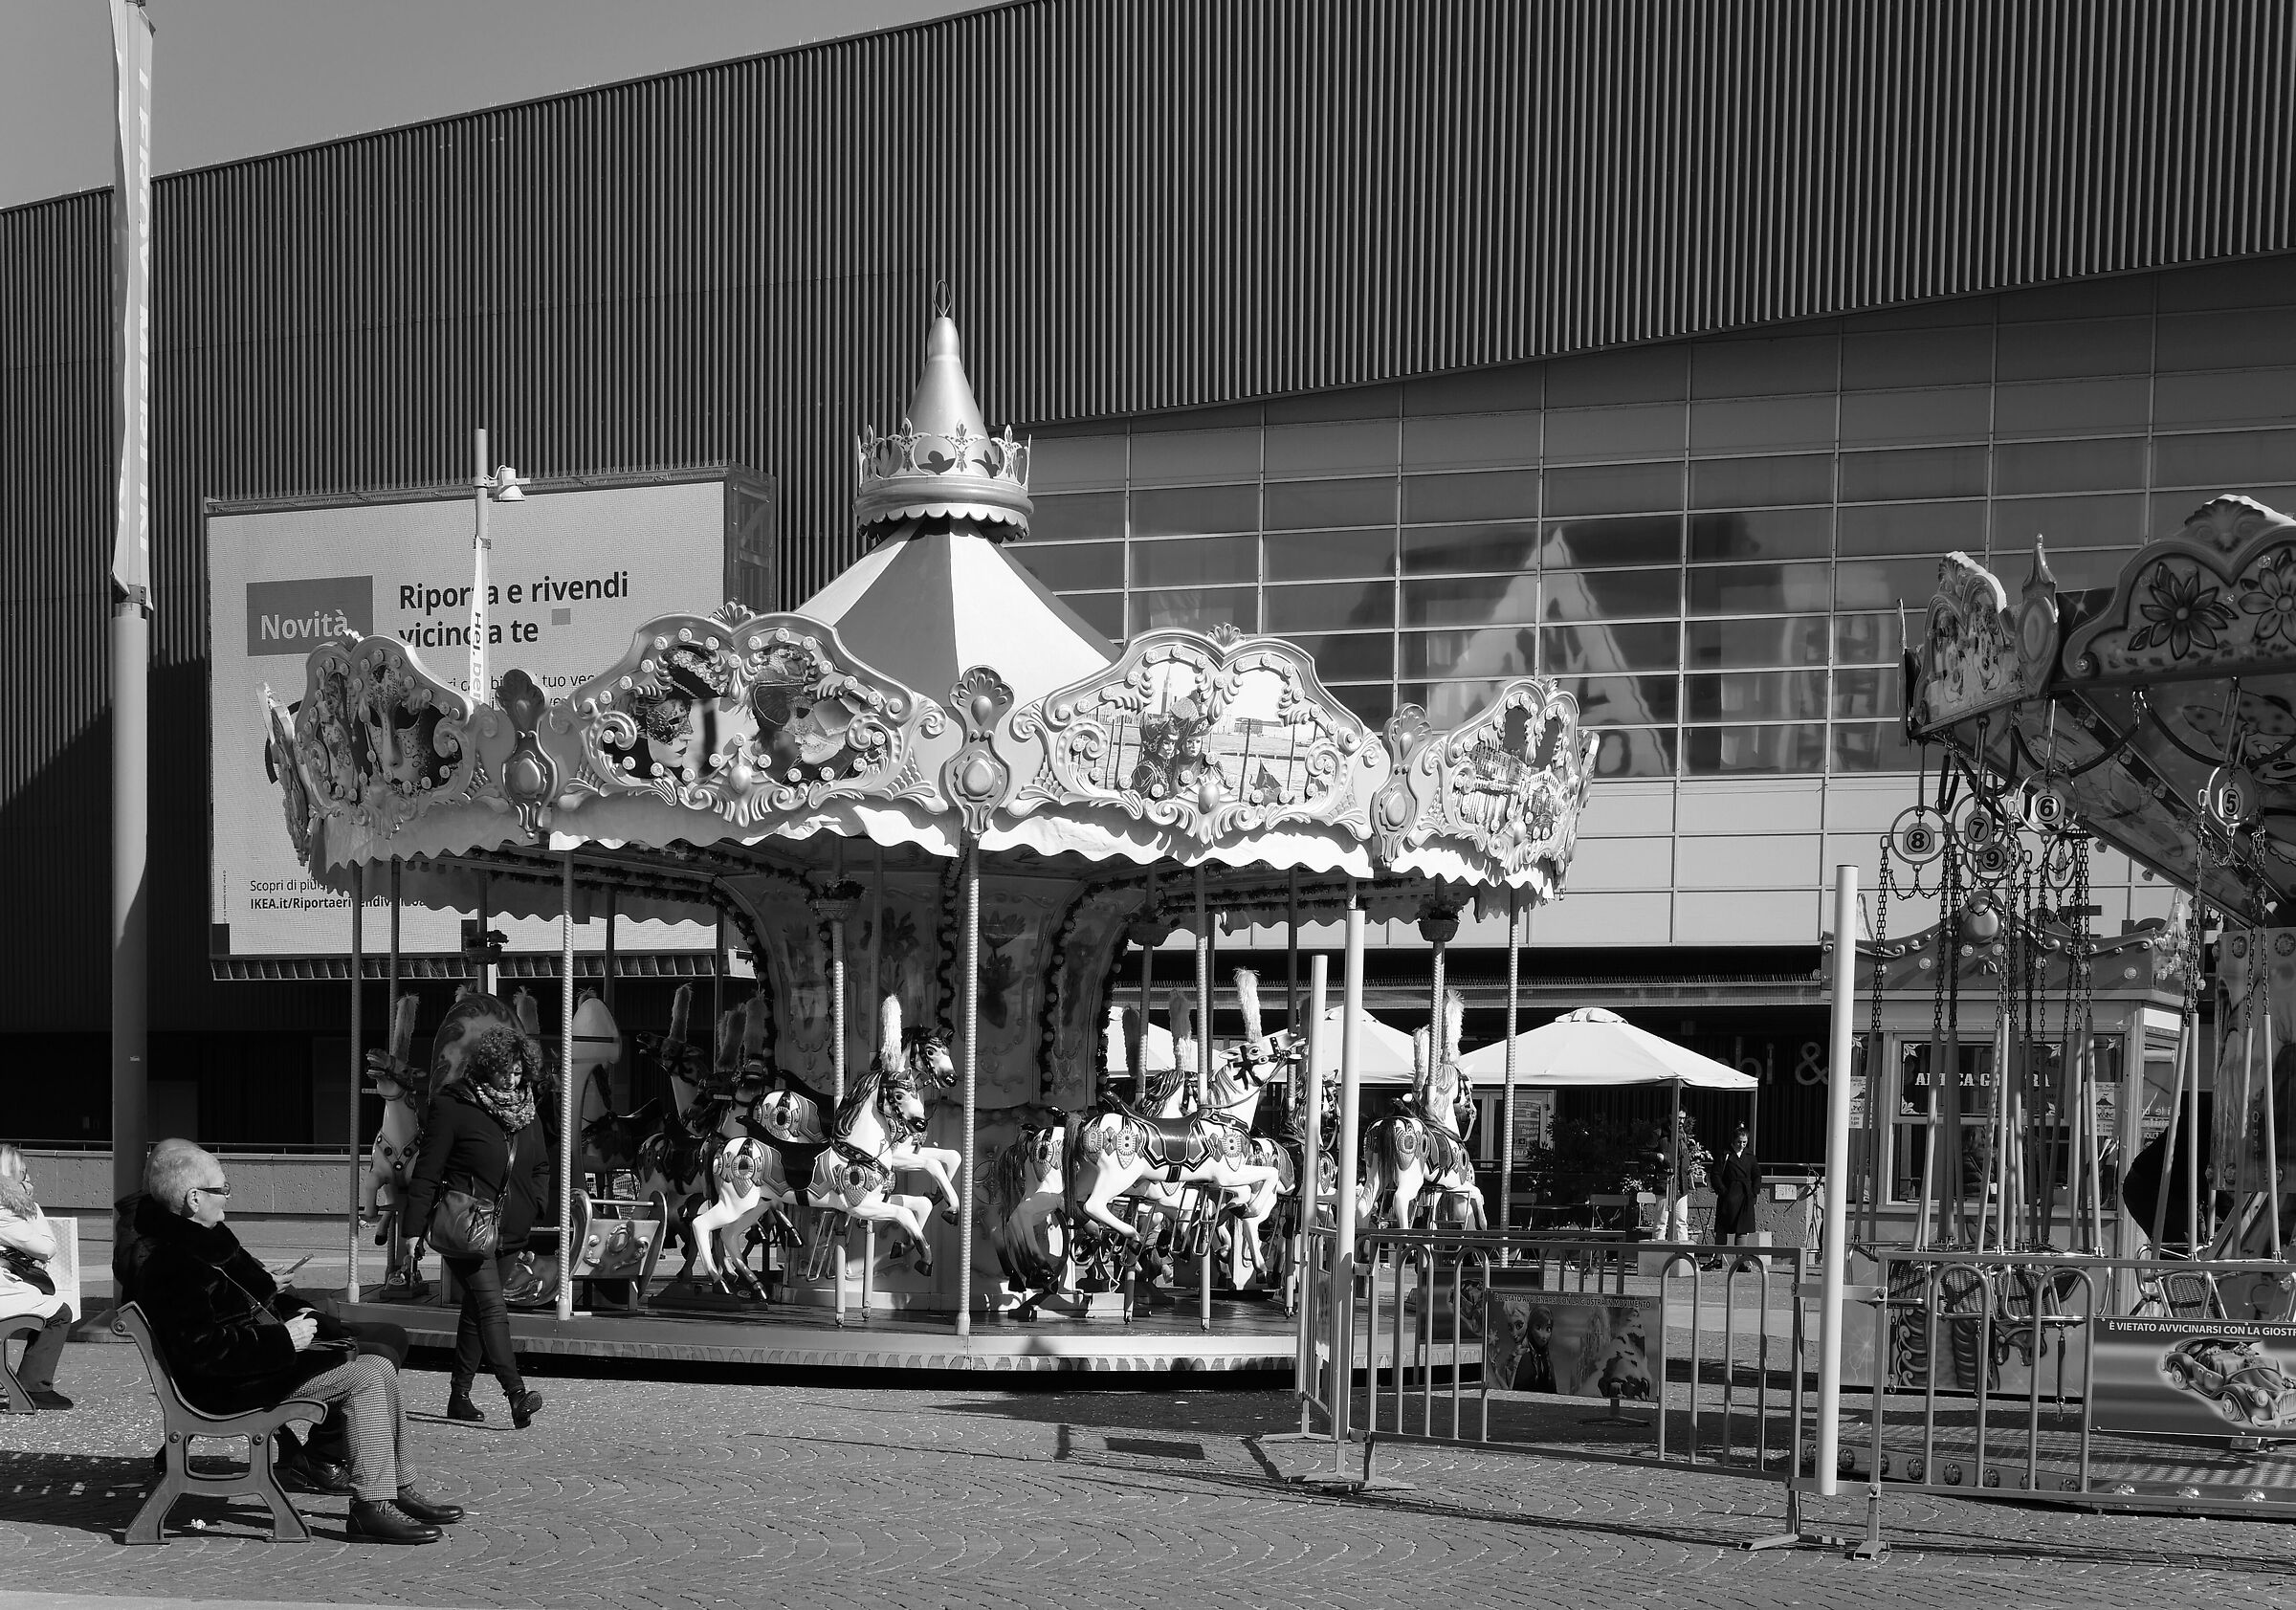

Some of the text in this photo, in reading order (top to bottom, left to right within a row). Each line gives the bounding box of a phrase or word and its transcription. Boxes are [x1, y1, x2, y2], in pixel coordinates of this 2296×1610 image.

[400, 571, 628, 616] Ripora e rivendi
[260, 608, 348, 640] Novità
[488, 624, 502, 645] a
[510, 620, 539, 643] te
[541, 674, 566, 688] tuo
[2040, 798, 2055, 815] 6
[2225, 793, 2237, 813] 5
[1973, 821, 1985, 839] 7
[1912, 831, 1926, 849] 8
[1986, 850, 1998, 867] 9
[250, 880, 284, 894] Scopri
[286, 879, 297, 891] di
[1795, 1041, 1829, 1086] &
[2108, 1320, 2115, 1331] È
[2116, 1322, 2157, 1332] VIETATO
[2158, 1324, 2221, 1334] AVVICINARSI
[2223, 1325, 2245, 1335] CON
[2247, 1326, 2261, 1335] LA
